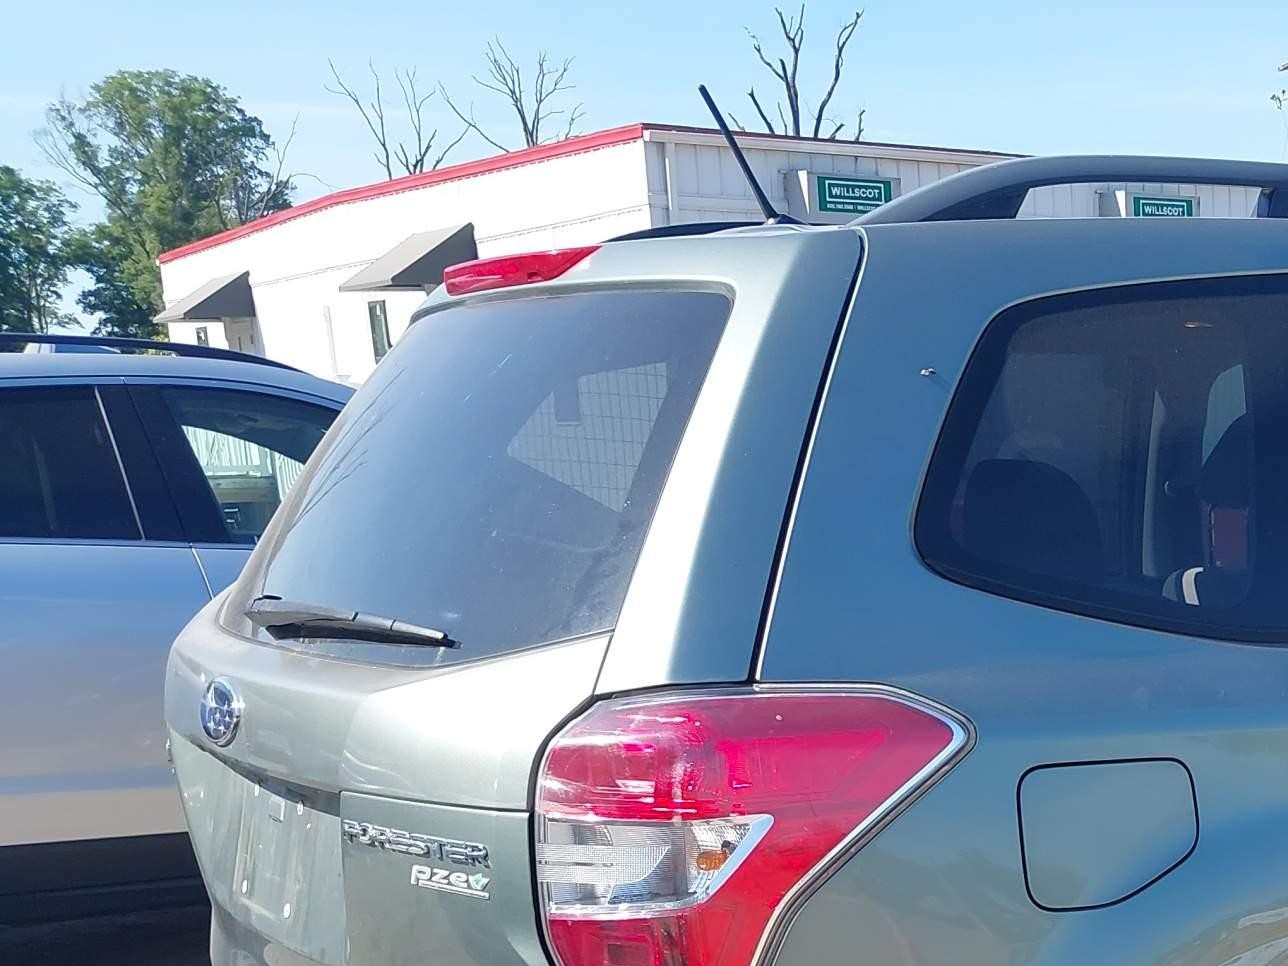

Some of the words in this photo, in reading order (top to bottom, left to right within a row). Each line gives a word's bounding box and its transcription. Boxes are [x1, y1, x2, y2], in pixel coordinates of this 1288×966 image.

[831, 186, 880, 198] WILLSCOT
[1144, 205, 1183, 216] WILLSCOT
[343, 819, 491, 868] FORESTER
